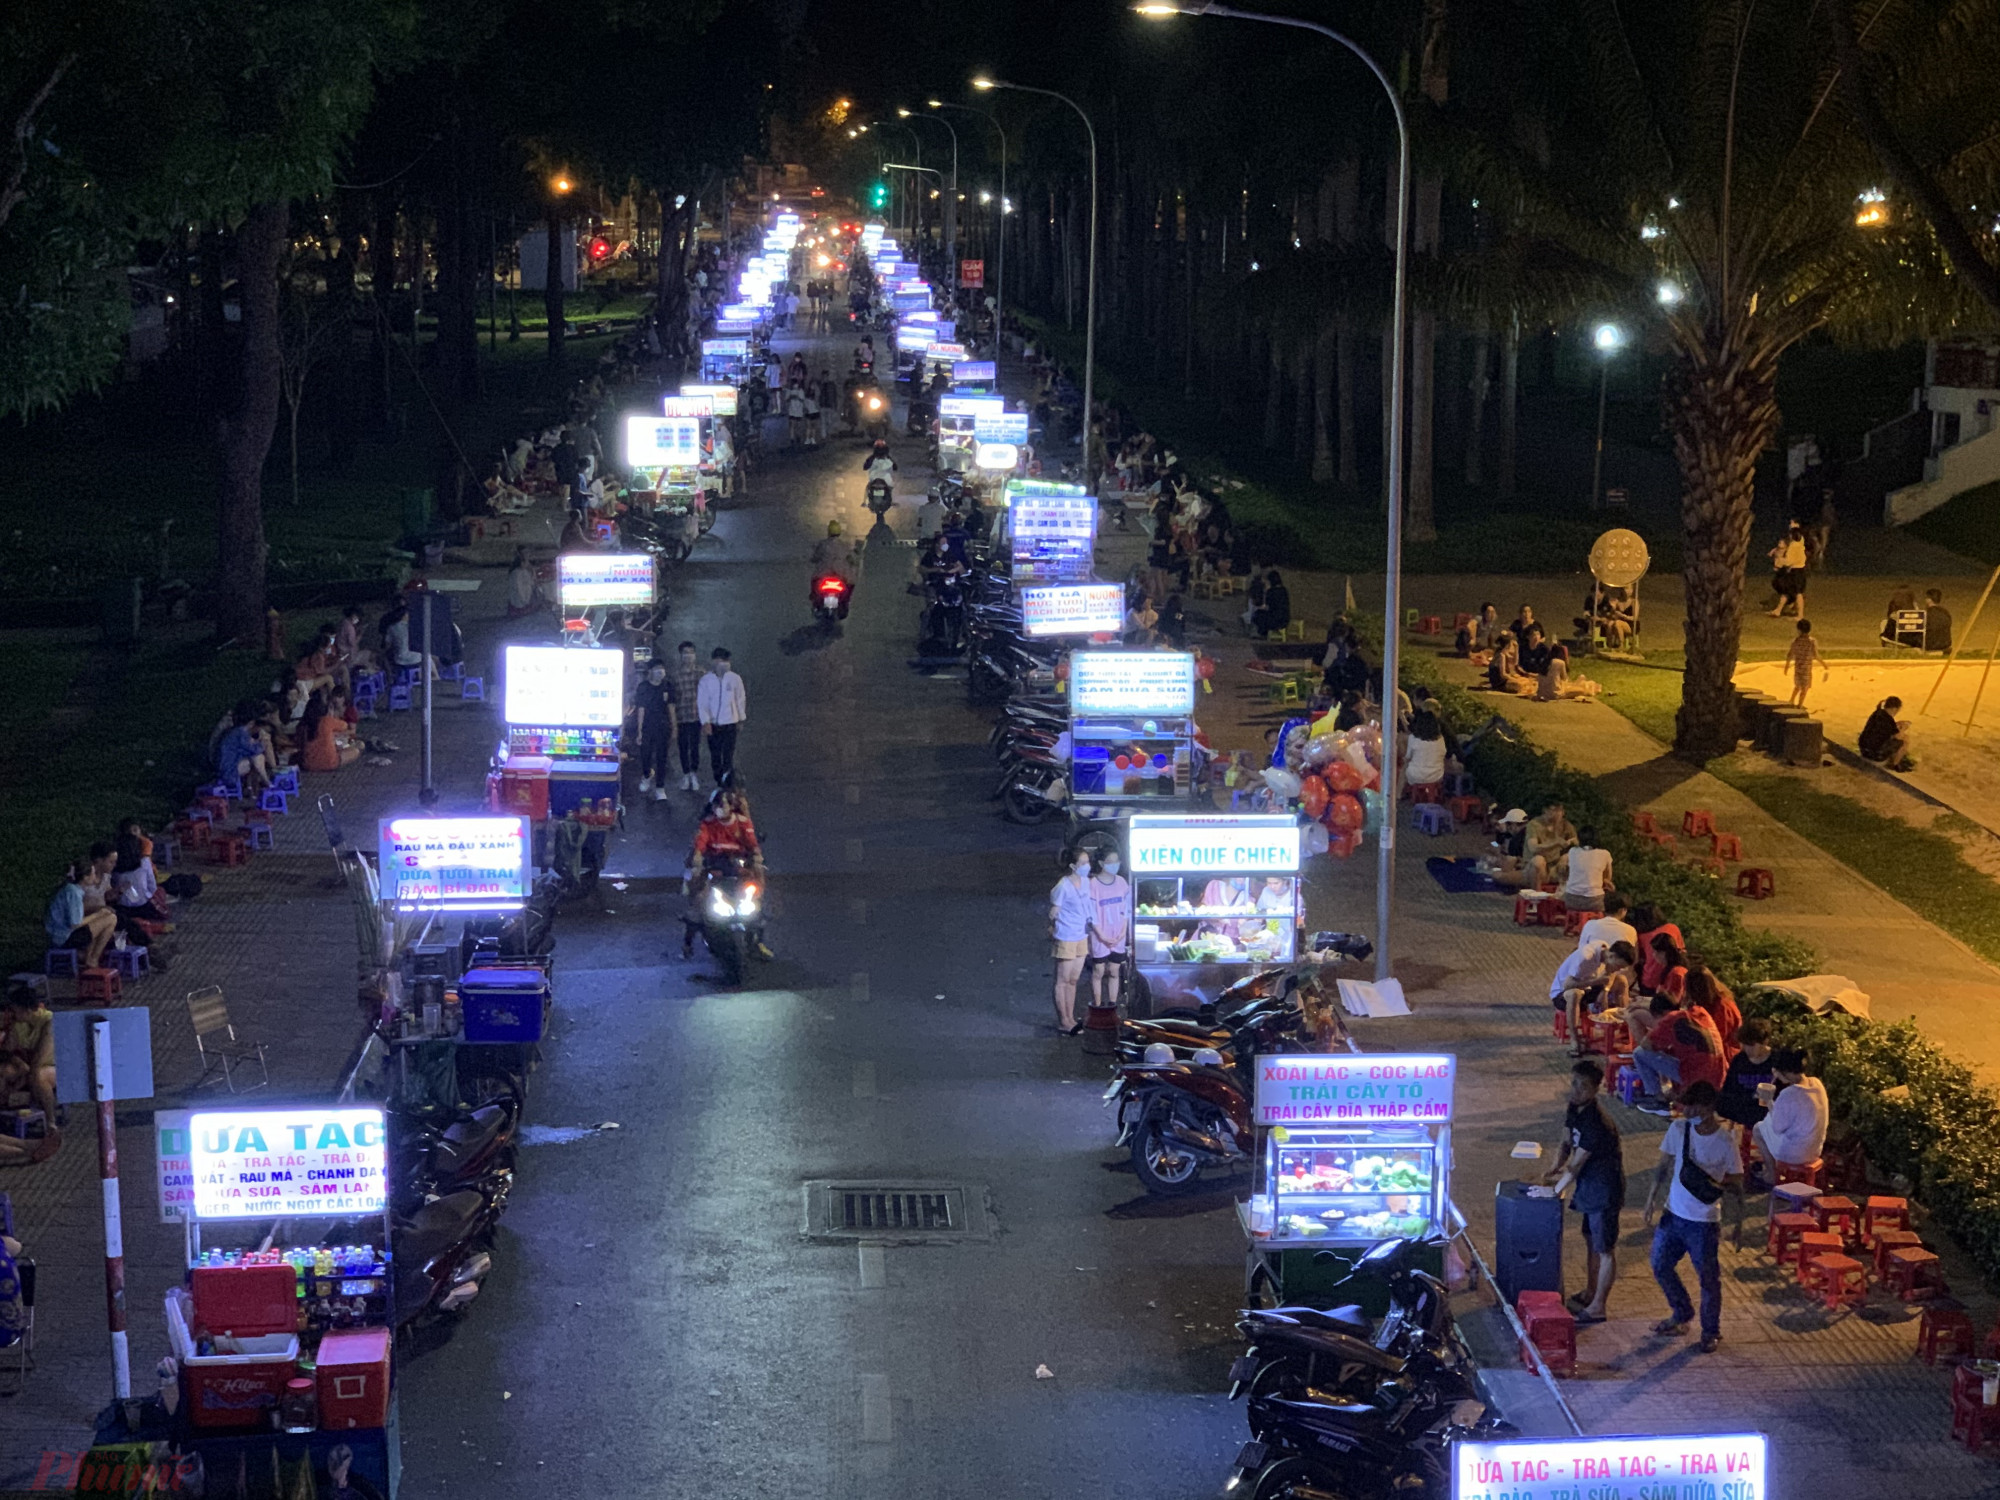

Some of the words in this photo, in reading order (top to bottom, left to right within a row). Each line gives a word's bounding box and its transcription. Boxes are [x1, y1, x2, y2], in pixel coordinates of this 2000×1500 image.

[394, 843, 421, 852] RAU
[1289, 1083, 1338, 1100] TRÁI
[1346, 1082, 1390, 1099] CÂY
[1263, 1103, 1297, 1120] TRÁI
[1302, 1102, 1332, 1118] CÂY
[163, 1174, 194, 1187] CAM
[239, 1172, 266, 1184] RAU
[307, 1167, 355, 1180] CHANH
[300, 1184, 338, 1196] SÂM
